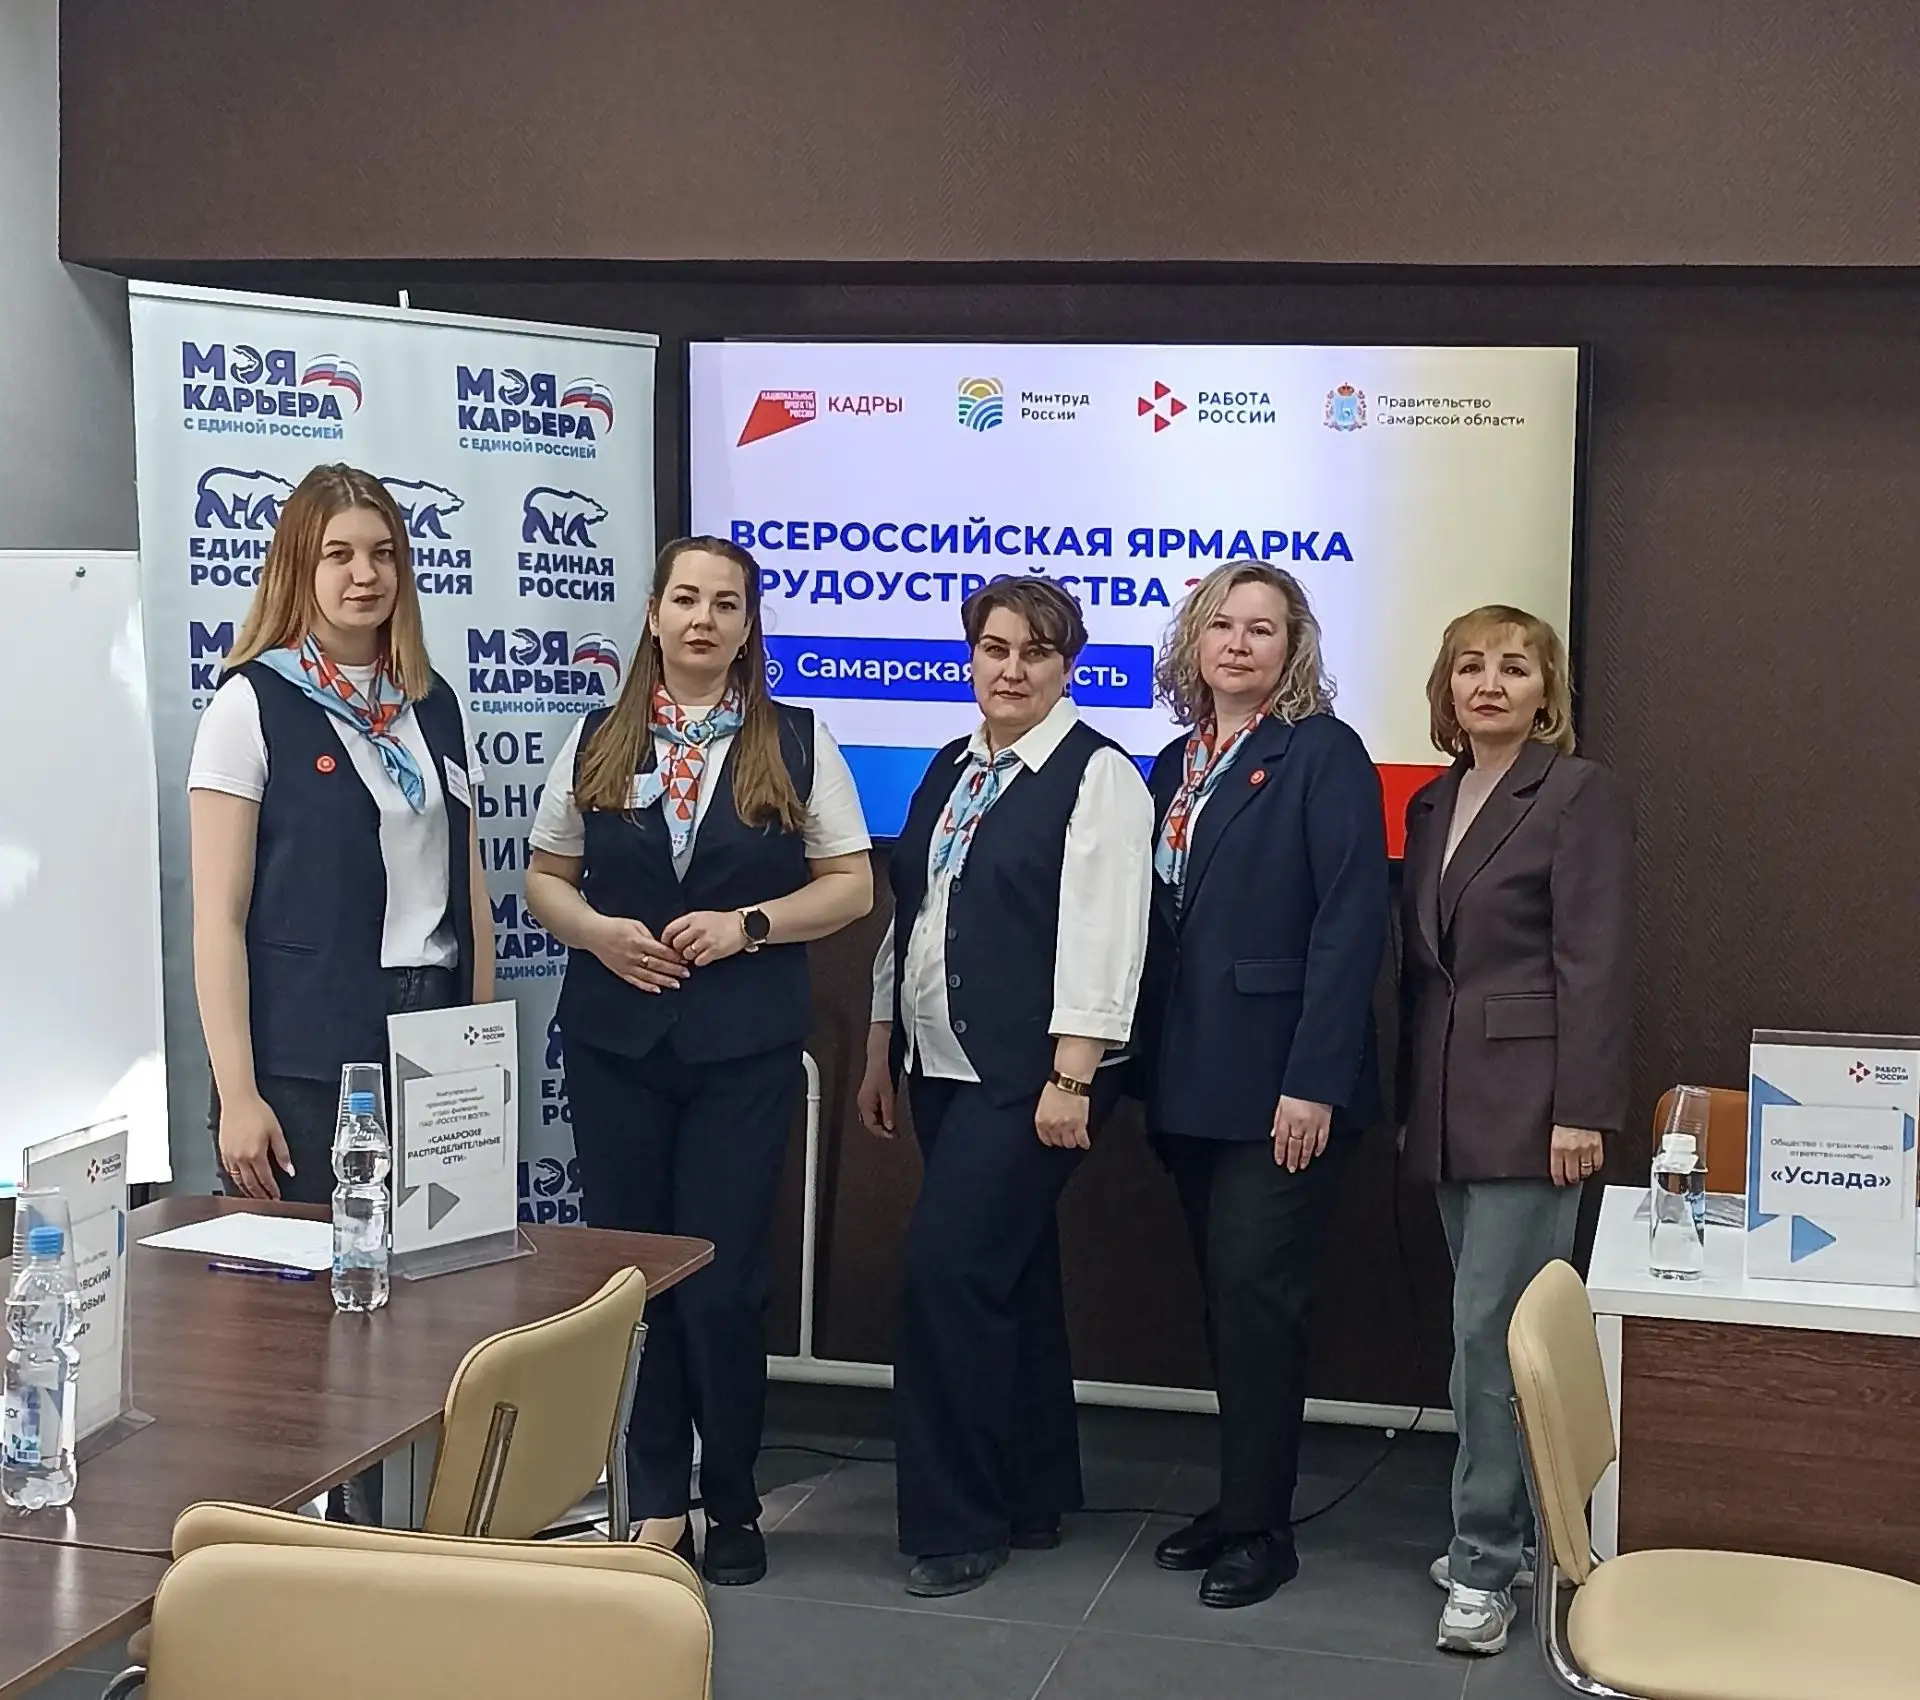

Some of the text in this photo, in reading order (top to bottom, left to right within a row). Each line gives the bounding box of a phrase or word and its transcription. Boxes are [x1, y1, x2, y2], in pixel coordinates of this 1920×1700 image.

[182, 341, 297, 387] МОЯ
[456, 365, 557, 408] МОЯ
[183, 383, 343, 420] КАРЬЕРА
[828, 395, 903, 416] КАДРЫ
[1021, 391, 1090, 407] Минтруд
[1198, 391, 1271, 406] РАБОТА
[1377, 395, 1492, 409] Правительство
[458, 405, 596, 441] КАРЬЕРА
[1021, 407, 1076, 421] России
[1198, 409, 1276, 424] РОССИИ
[1376, 412, 1525, 427] Самарской области
[183, 417, 344, 440] С ЕДИНОЙ РОССИЕЙ
[459, 436, 597, 459] С ЕДИНОЙ РОССИЕЙ
[730, 516, 1354, 562] ВСЕРОССИЙСКАЯ ЯРМАРКА
[518, 551, 614, 577] ЕДИНАЯ
[519, 576, 615, 602] РОССИЯ
[467, 627, 570, 666] МОЯ
[469, 668, 606, 696] КАРЬЕРА
[470, 700, 480, 712] С
[482, 697, 545, 714] ЕДИНОЙ
[407, 1136, 502, 1159] РАСПРЕДЕЛИТЕЛЬНЫЕ
[1770, 1165, 1892, 1190] «Услада»
